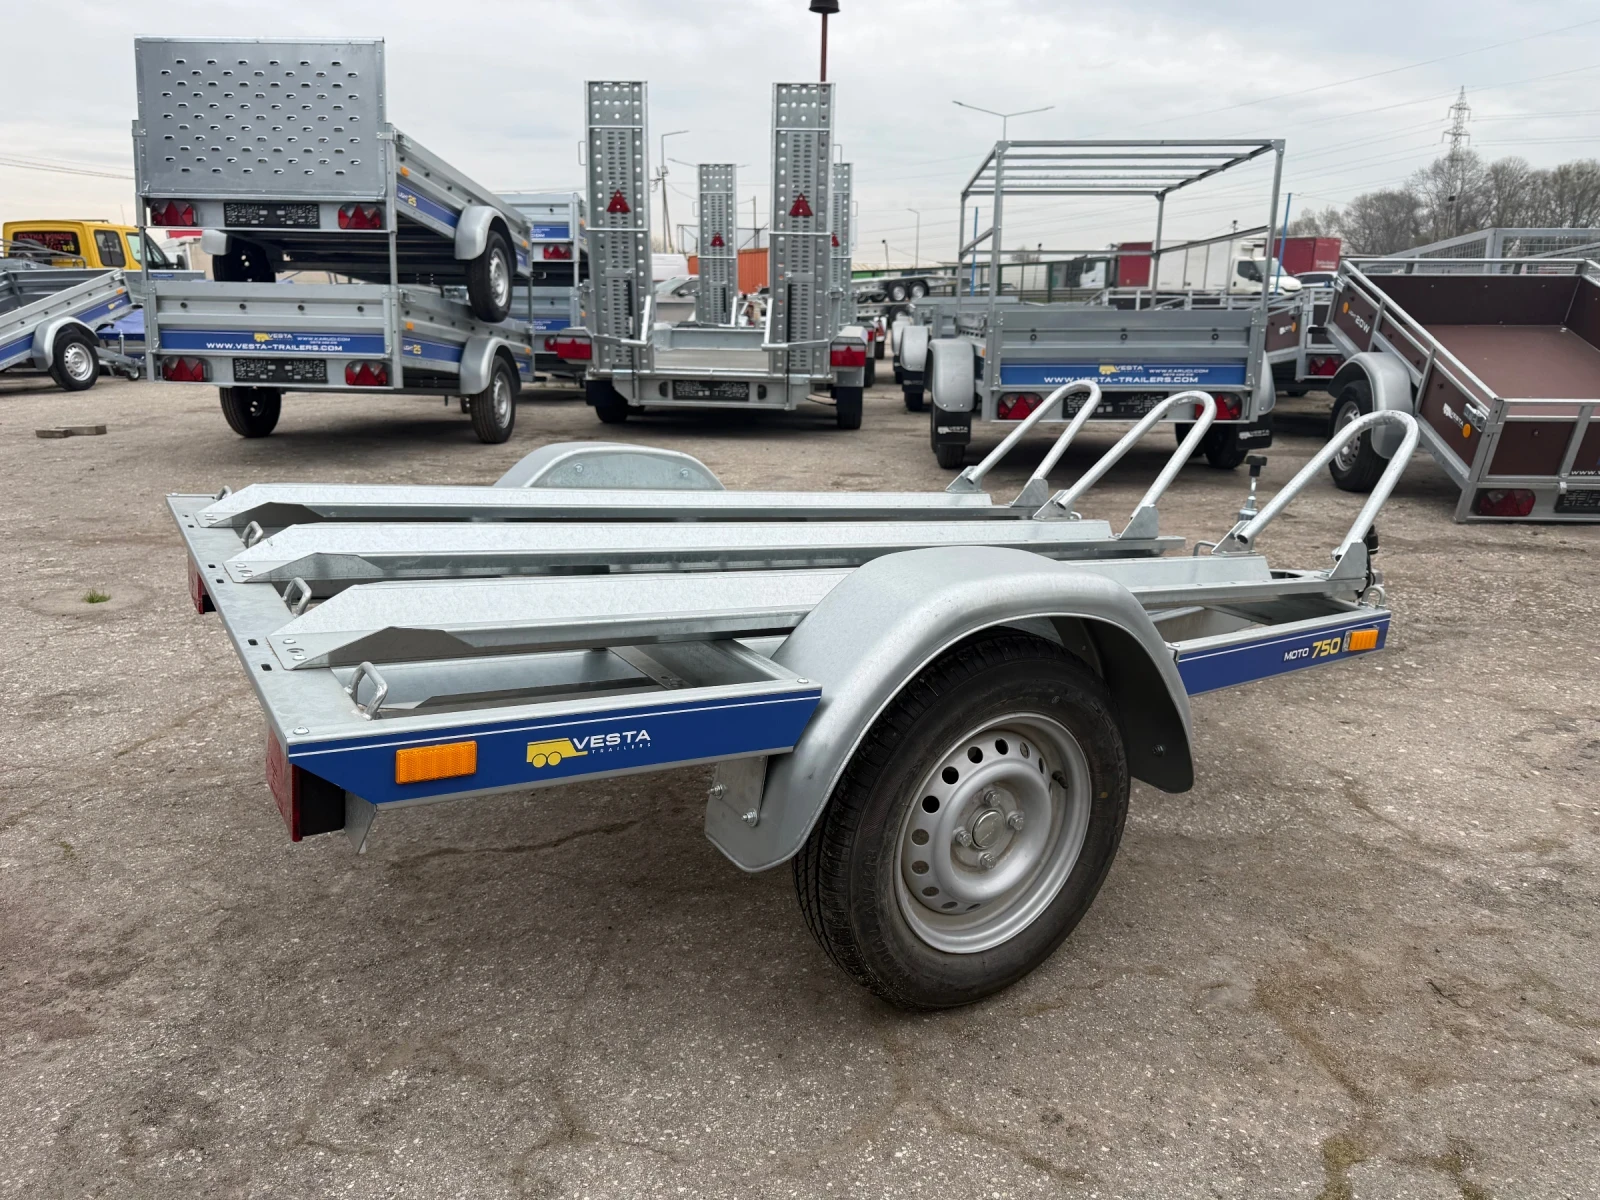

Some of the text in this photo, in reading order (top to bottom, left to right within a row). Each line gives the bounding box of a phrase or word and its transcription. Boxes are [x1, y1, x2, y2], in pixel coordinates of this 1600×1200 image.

[206, 342, 342, 351] WWW.VESTA-TRAILERS.COM
[1044, 376, 1199, 384] WWWVESTA-TRAILERS.COM
[1284, 637, 1341, 661] MOTO 750
[573, 730, 651, 749] VESTA
[592, 742, 651, 754] TRAILERS
